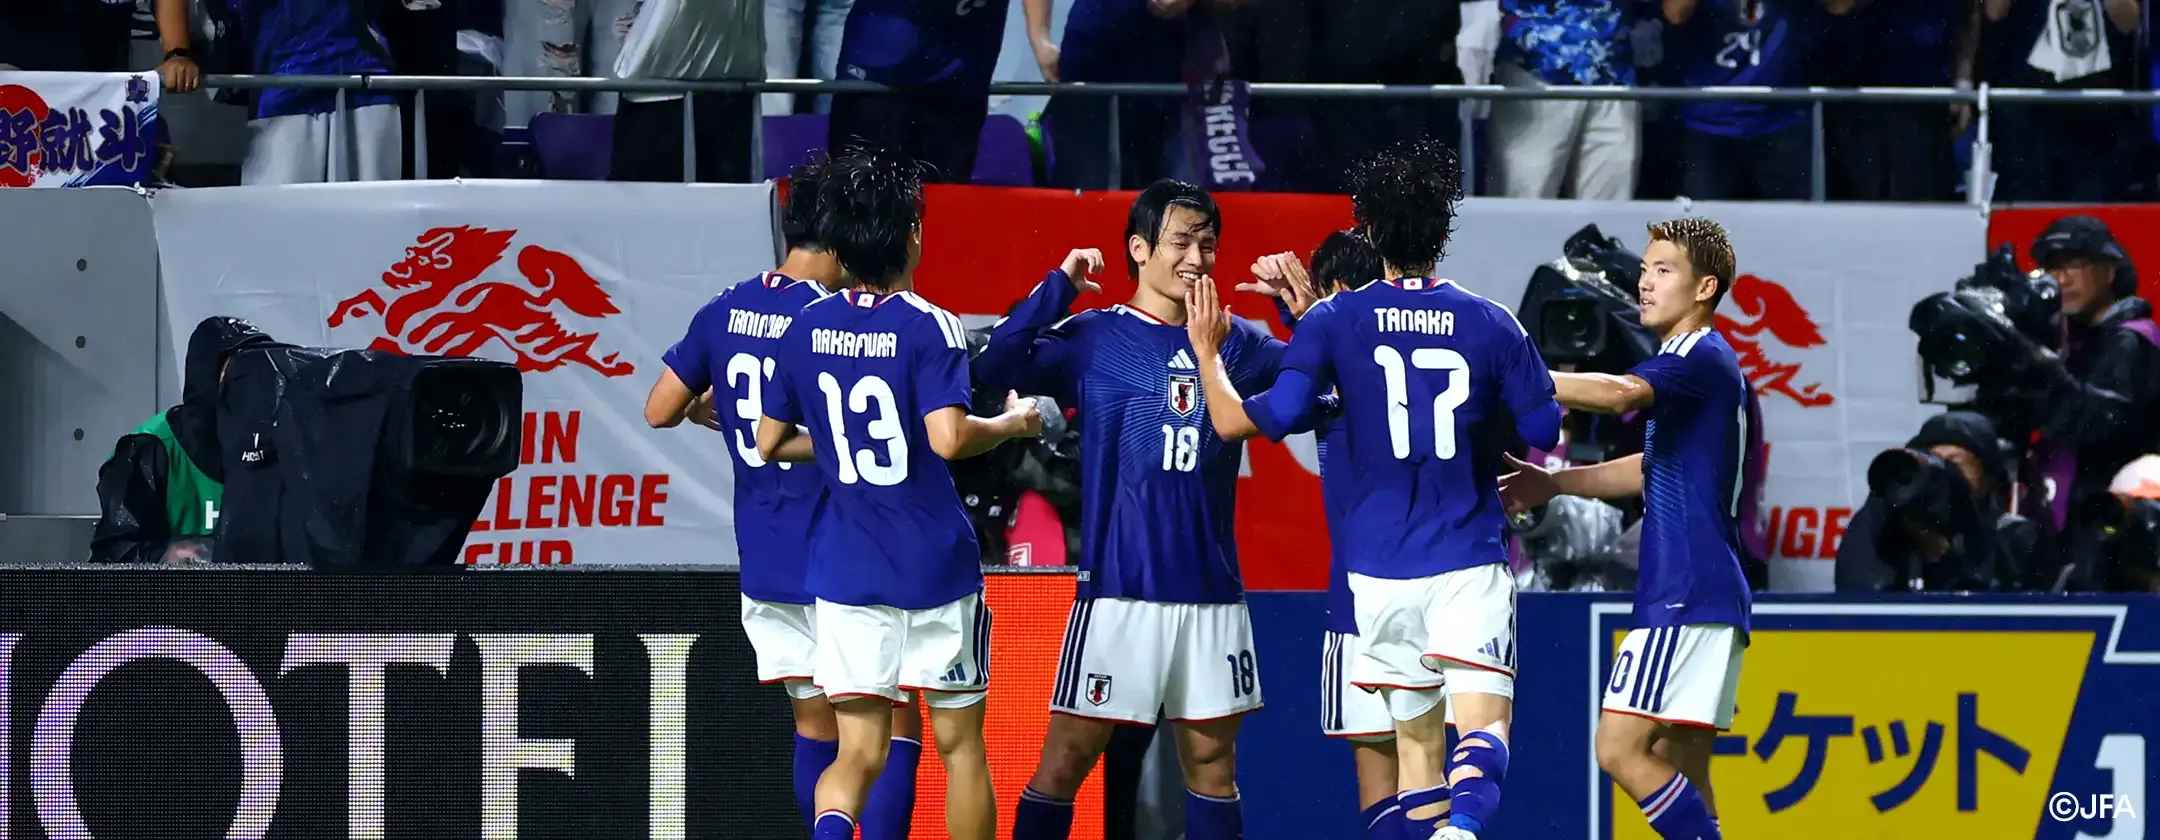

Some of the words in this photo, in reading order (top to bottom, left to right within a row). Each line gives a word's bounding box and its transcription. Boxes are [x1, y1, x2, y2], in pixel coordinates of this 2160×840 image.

[811, 328, 897, 358] NAKAMURA
[1374, 307, 1454, 336] TANAKA
[726, 352, 793, 471] 3
[817, 371, 909, 486] 13
[1374, 344, 1470, 460] 17
[1162, 424, 1200, 472] 18
[469, 474, 669, 532] LENGE
[1227, 650, 1255, 699] 18
[0, 625, 700, 840] OTEL
[1711, 692, 2031, 814] ケット
